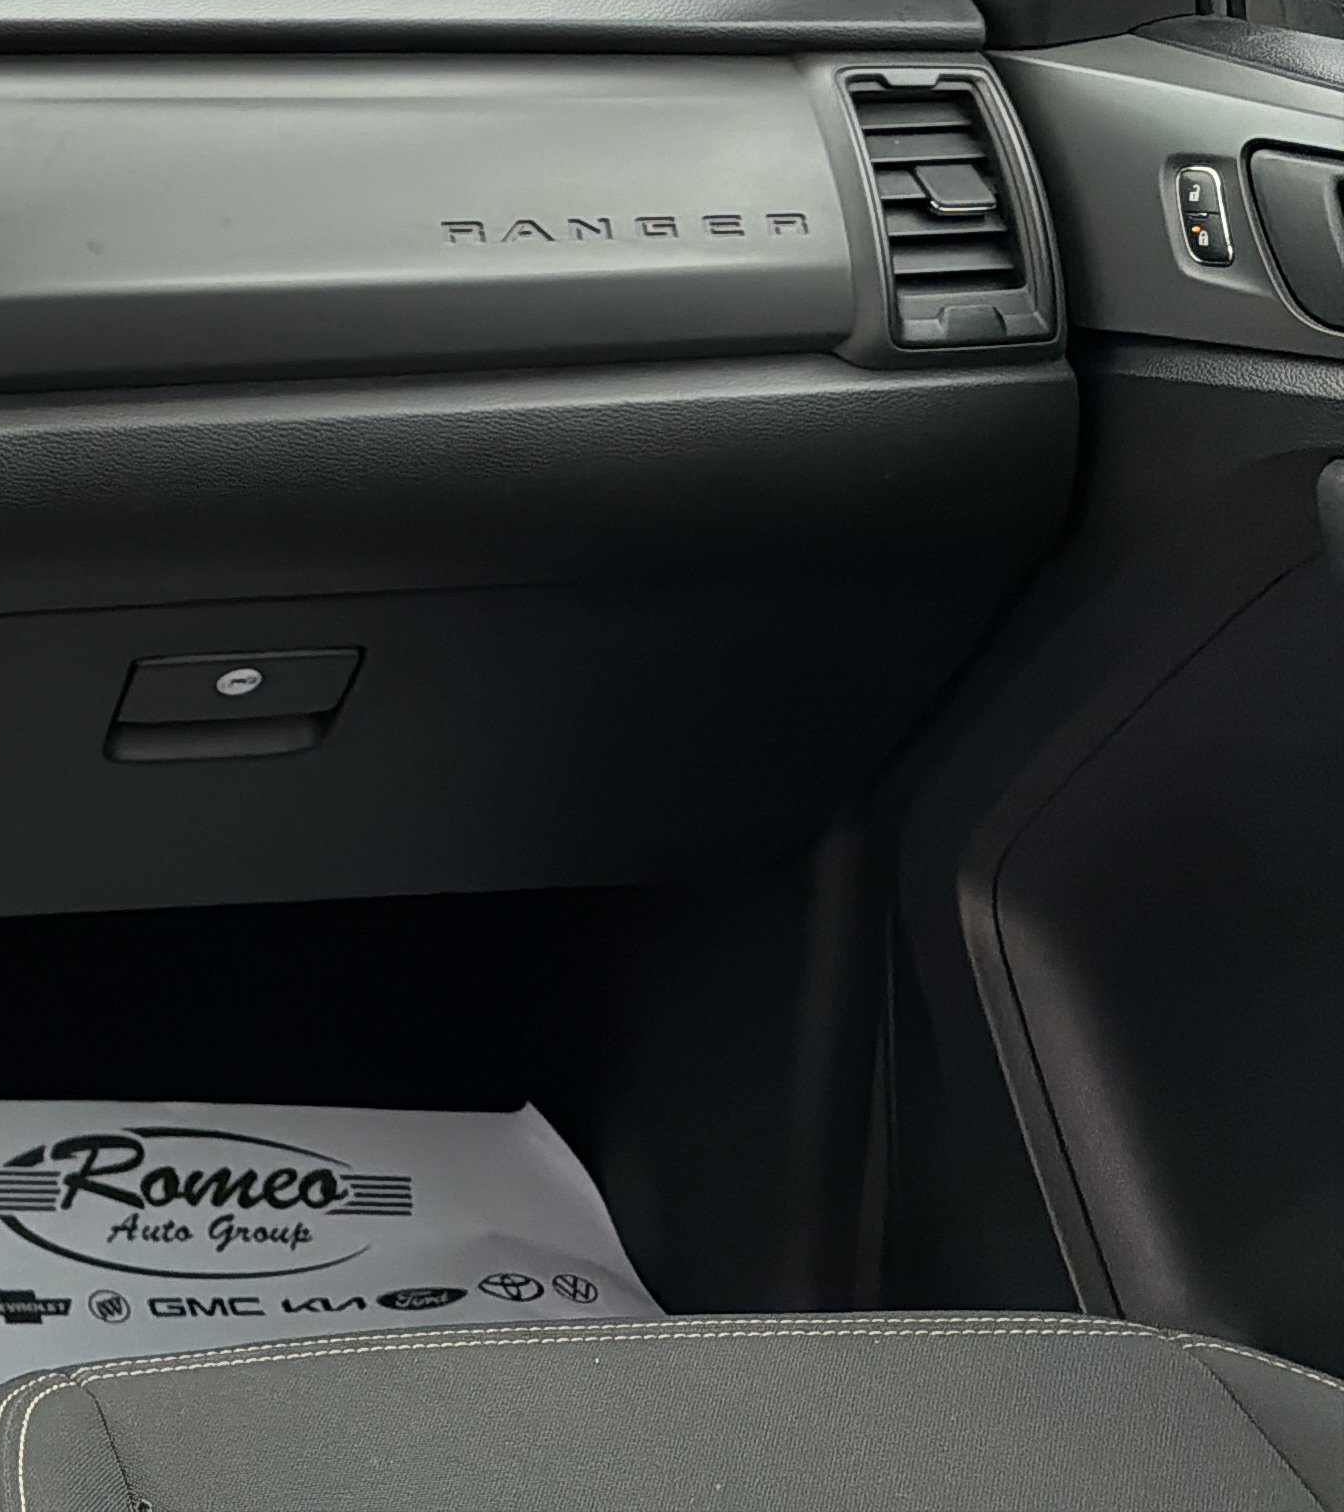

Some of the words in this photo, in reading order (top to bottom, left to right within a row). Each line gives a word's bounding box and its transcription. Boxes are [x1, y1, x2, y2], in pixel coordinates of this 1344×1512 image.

[441, 212, 810, 244] RANGER
[50, 1133, 351, 1214] Romeo
[107, 1214, 193, 1244] Auto
[208, 1213, 314, 1252] Group
[148, 1296, 265, 1317] GMC
